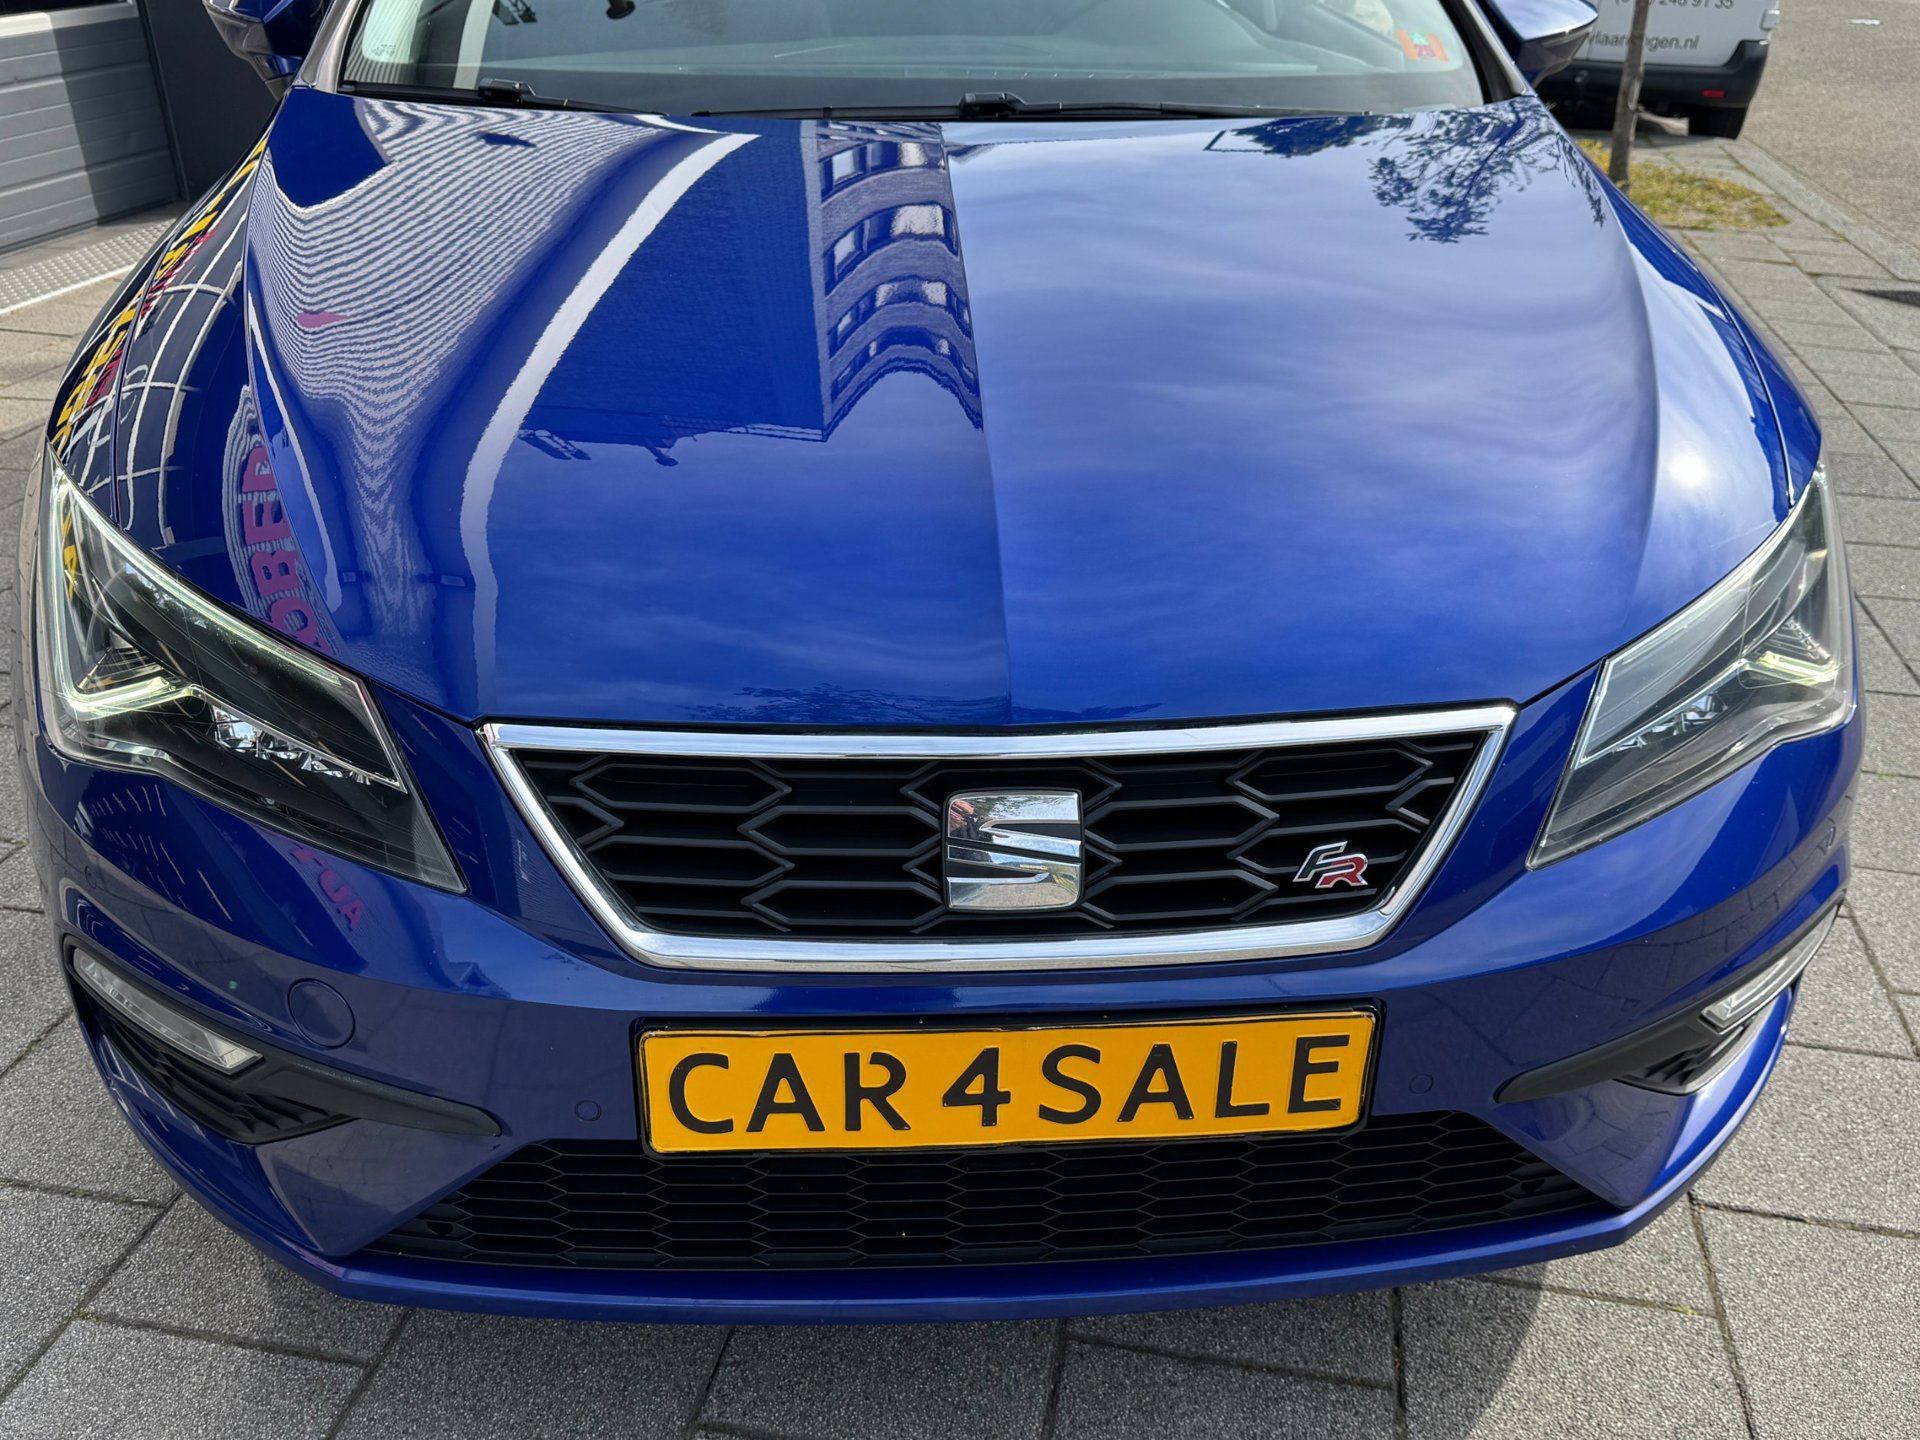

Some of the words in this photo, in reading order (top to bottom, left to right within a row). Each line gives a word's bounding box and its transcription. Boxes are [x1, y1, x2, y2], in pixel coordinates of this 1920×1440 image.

[1588, 30, 1699, 52] vlaargen.nl
[1292, 840, 1369, 889] FR
[668, 1051, 911, 1134] CAR
[941, 1046, 1012, 1127] 4
[1038, 1034, 1350, 1124] SALE
